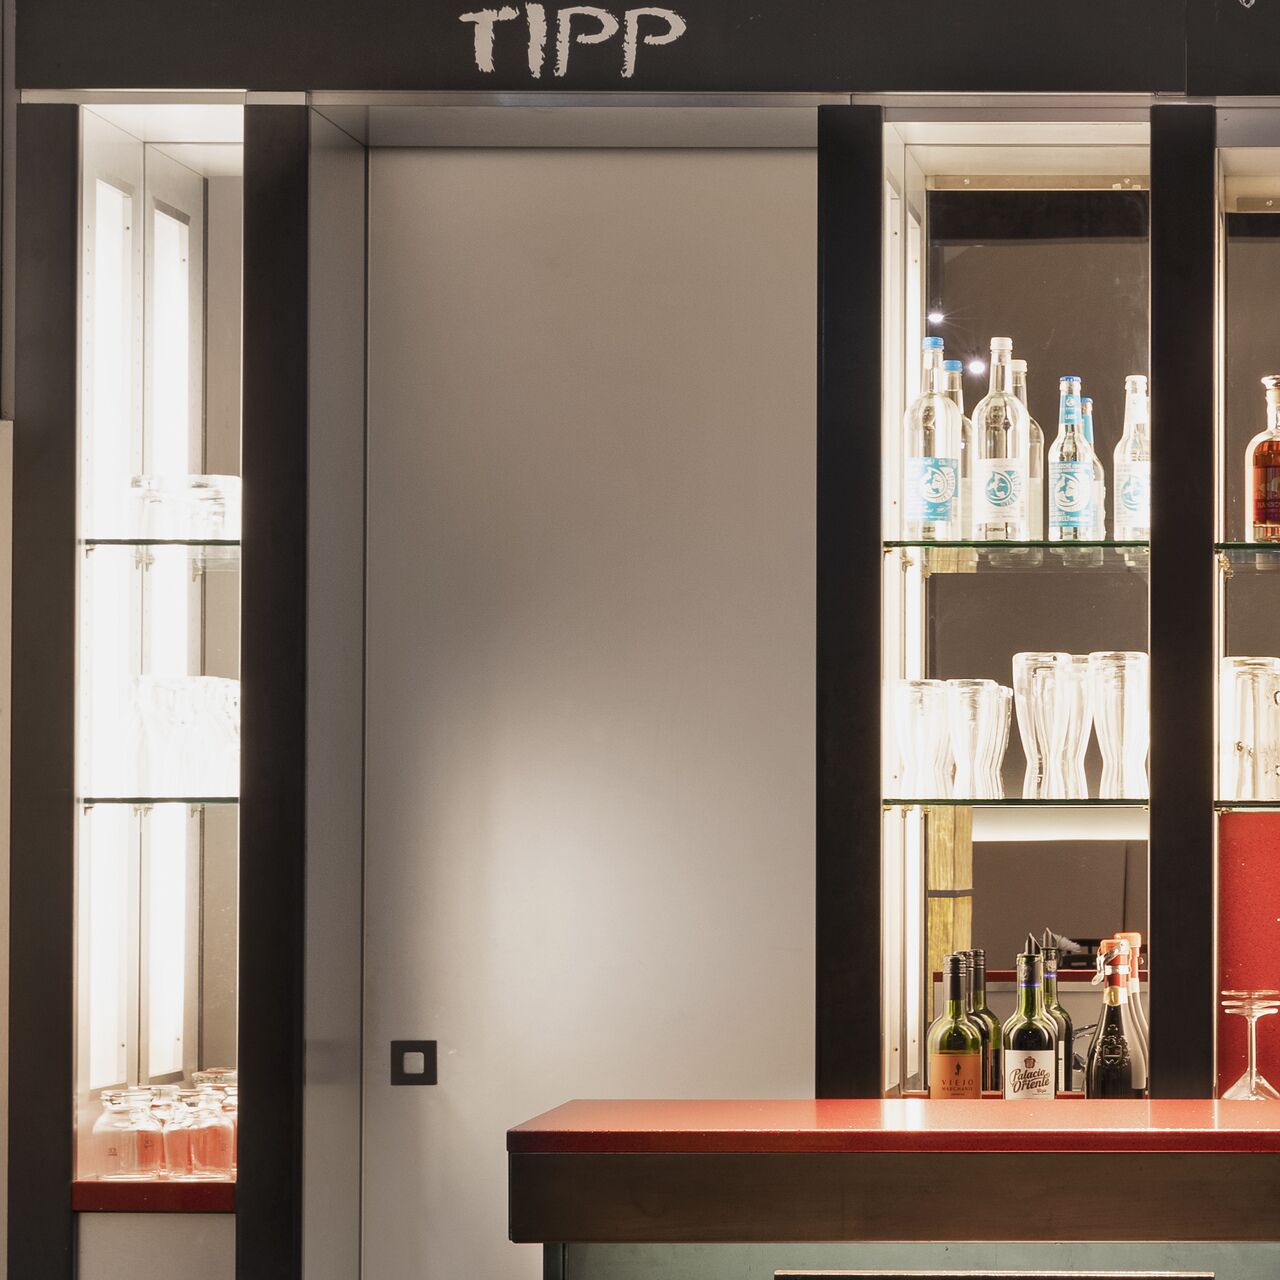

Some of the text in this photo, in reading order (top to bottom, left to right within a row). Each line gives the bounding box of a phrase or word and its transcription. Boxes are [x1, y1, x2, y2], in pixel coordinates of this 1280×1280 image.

[458, 3, 687, 79] TIPP
[1009, 1068, 1045, 1083] Palacio
[1013, 1073, 1050, 1094] Oriente
